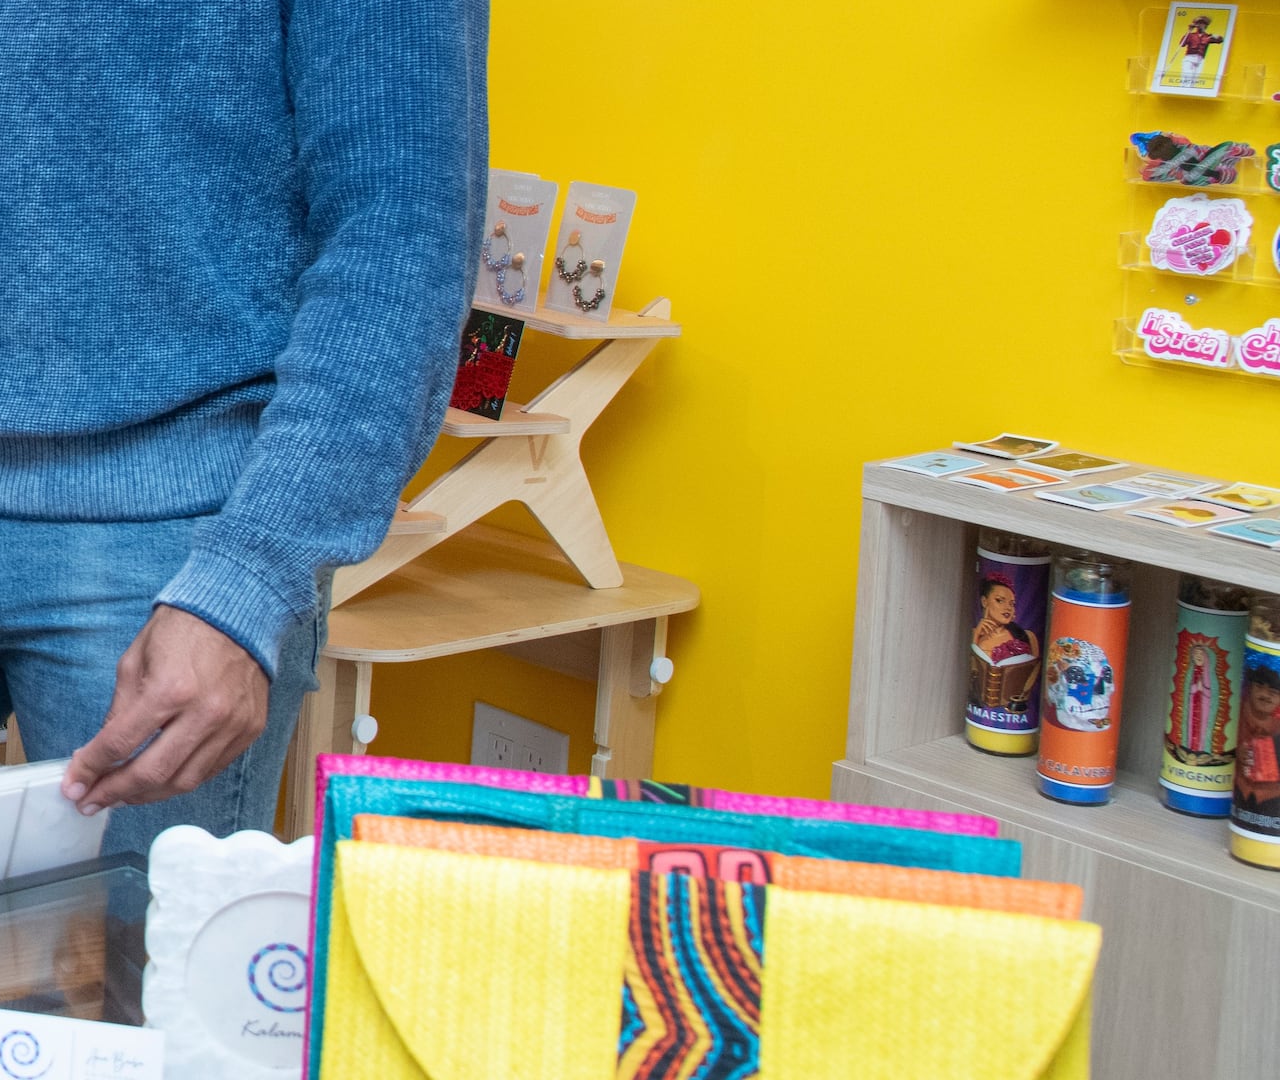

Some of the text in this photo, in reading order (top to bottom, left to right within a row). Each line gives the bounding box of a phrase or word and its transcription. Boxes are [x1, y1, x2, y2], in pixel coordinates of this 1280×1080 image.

[1142, 311, 1164, 335] hi
[1149, 323, 1220, 362] Sucia
[973, 705, 1029, 724] MAESTRA
